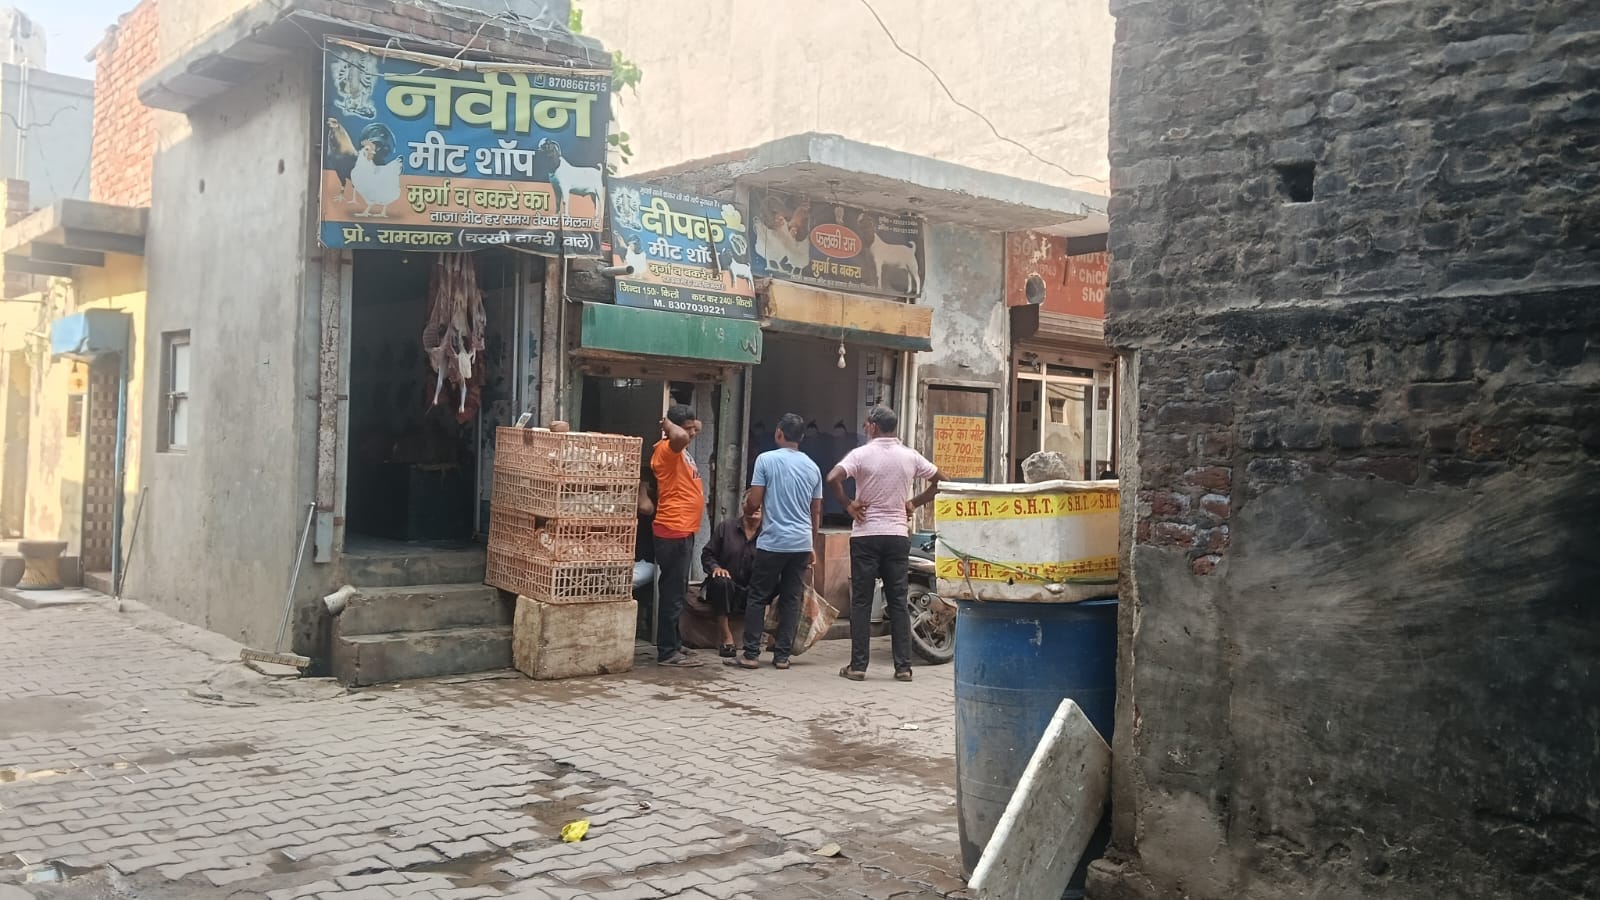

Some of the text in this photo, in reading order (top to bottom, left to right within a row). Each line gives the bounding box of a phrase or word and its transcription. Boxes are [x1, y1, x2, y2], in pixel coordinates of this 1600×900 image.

[548, 76, 607, 92] 8708667515
[383, 70, 599, 137] नवीन
[407, 130, 536, 177] मीट शॉप
[407, 179, 550, 212] मुर्गा व बकरे का
[430, 211, 458, 222] ताजा
[460, 209, 482, 224] मीट
[484, 214, 500, 226] हर
[502, 214, 531, 226] समय
[562, 213, 591, 228] मिलता
[639, 197, 727, 243] दीपक
[342, 223, 371, 245] प्रो.
[377, 229, 453, 246] रामलाल
[648, 237, 683, 261] मीट
[649, 262, 672, 277] मुर्गा
[673, 266, 682, 276] व
[811, 257, 830, 277] मुर्गा
[831, 263, 838, 276] व
[653, 299, 726, 315] M. 8307039221
[660, 286, 680, 299] किलो
[735, 295, 753, 308] किलो
[955, 500, 993, 516] S.H.T.
[1013, 497, 1054, 515] S.H.T.
[1067, 495, 1089, 512] S.H.T.
